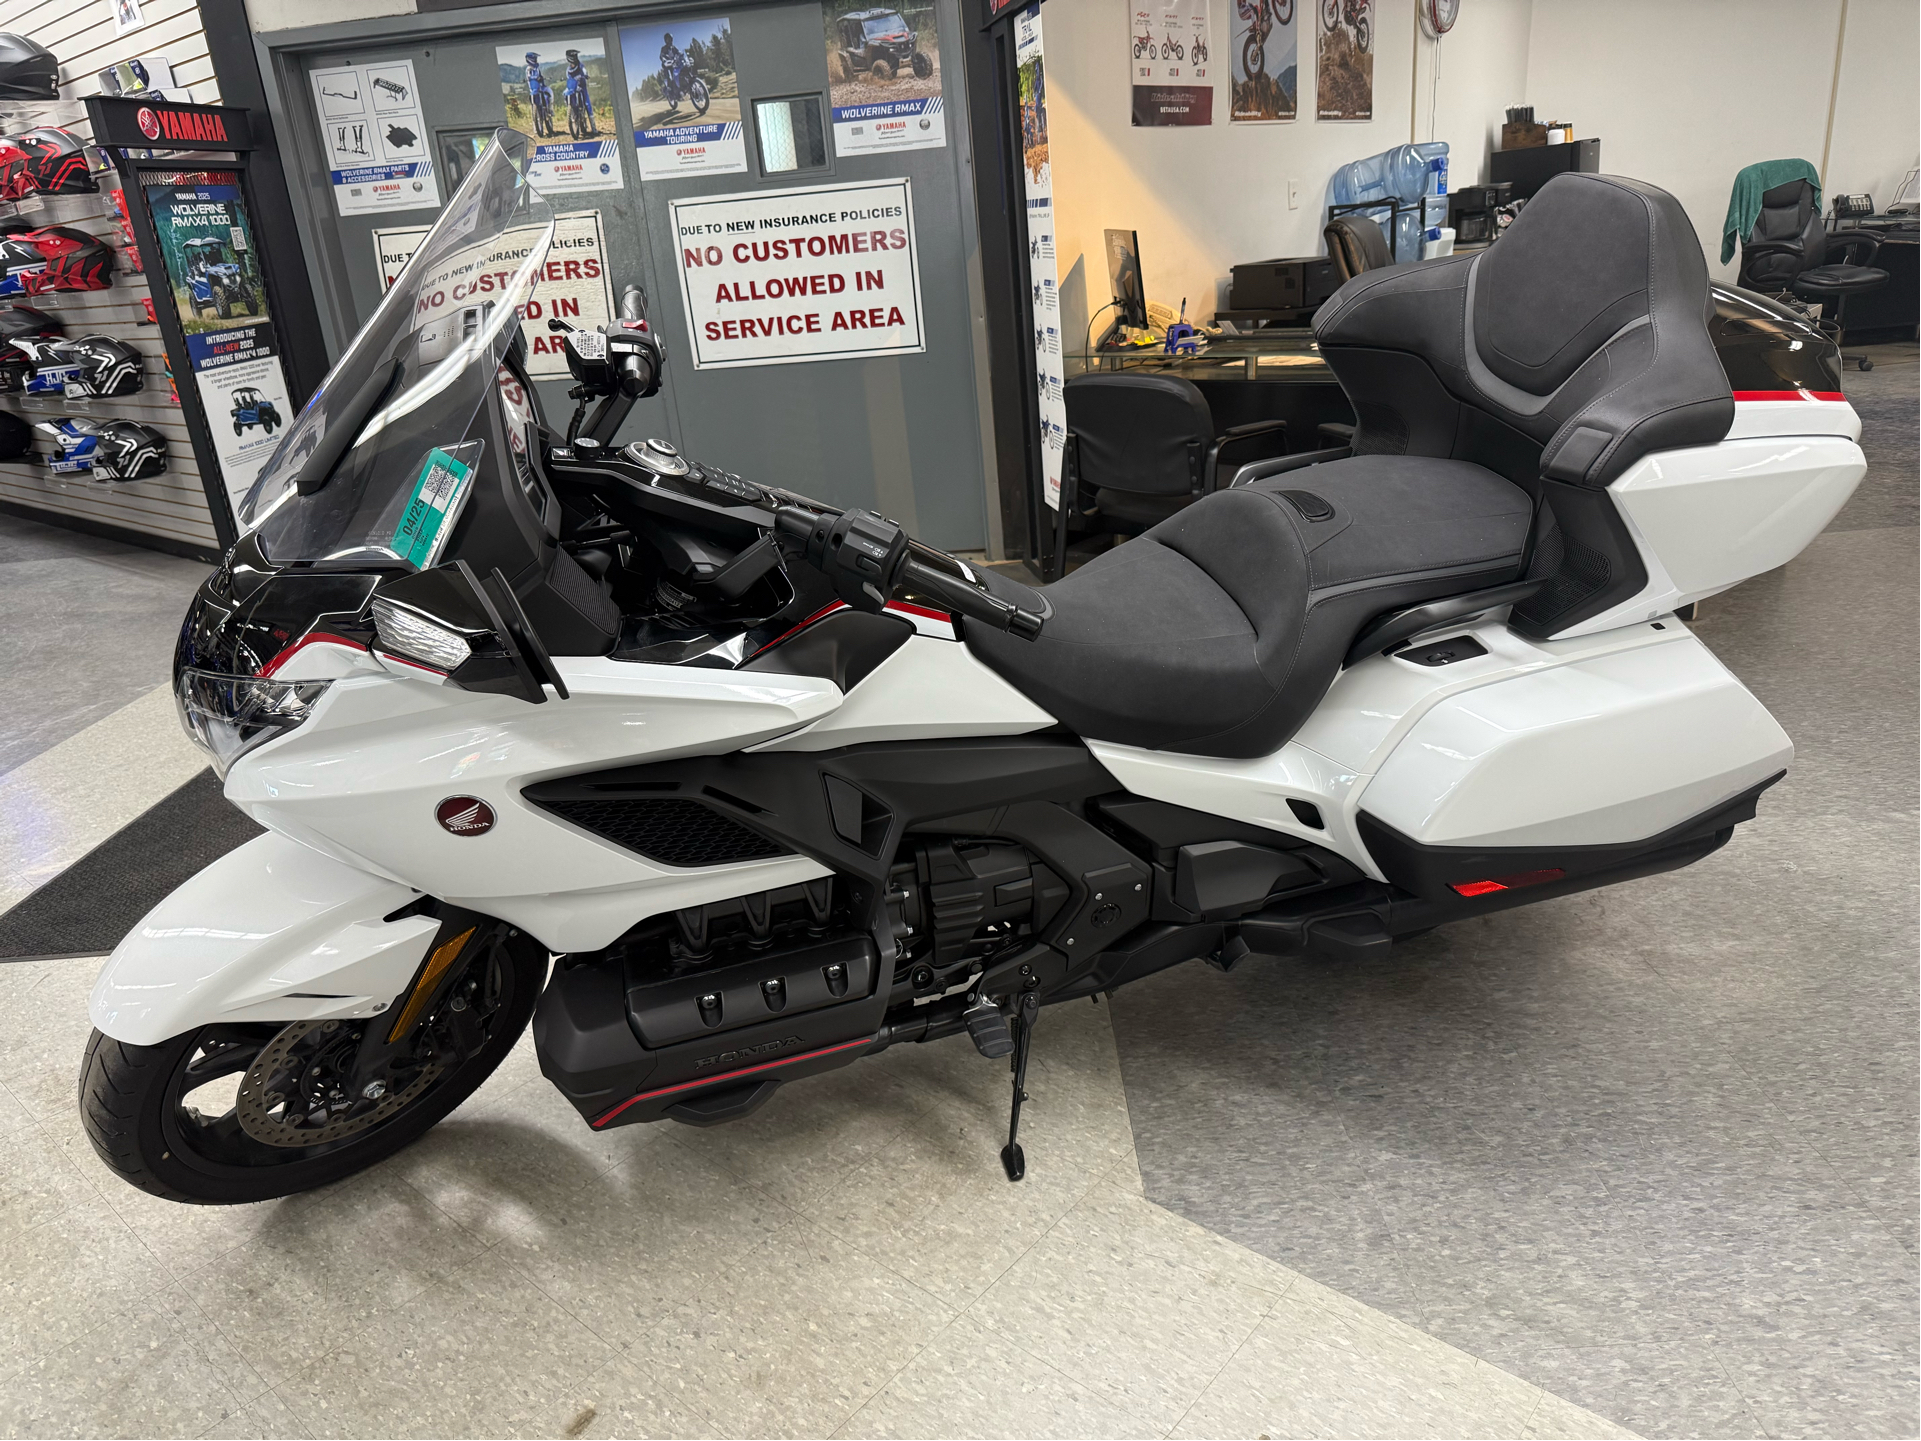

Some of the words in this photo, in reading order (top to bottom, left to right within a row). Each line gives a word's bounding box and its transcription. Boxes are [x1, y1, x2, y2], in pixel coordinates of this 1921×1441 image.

[841, 105, 893, 119] WOLVERINE
[895, 102, 922, 113] RMAX
[156, 110, 228, 142] YAMAHA
[644, 129, 674, 139] YAMAHA
[675, 125, 718, 136] ADVENTURE
[882, 121, 906, 130] YAMAHA
[666, 134, 698, 144] TOURING
[544, 144, 574, 154] YAMAHA
[683, 147, 706, 155] YAMAHA
[533, 153, 555, 162] CROSS
[556, 151, 589, 160] COUNTRY
[340, 168, 373, 178] WOLVERINE
[373, 166, 390, 174] RMAX
[391, 164, 409, 172] PARTS
[560, 164, 583, 172] YAMAHA
[347, 174, 385, 183] ACCESSORIES
[378, 183, 401, 192] YAMAHA
[197, 192, 211, 200] 2025
[170, 203, 226, 215] WOLVERINE
[209, 214, 231, 225] 1000
[681, 225, 704, 236] DUE
[705, 223, 722, 234] TO
[726, 220, 755, 233] NEW
[759, 212, 837, 230] INSURANCE
[840, 206, 903, 222] POLICIES
[683, 245, 724, 269] NO
[732, 228, 907, 264] CUSTOMERS
[383, 254, 404, 264] DUE
[421, 278, 437, 292] DUE
[438, 272, 449, 284] TO
[451, 263, 474, 278] NEW
[551, 237, 595, 249] LICIES
[715, 273, 846, 304] ALLOWED
[855, 269, 885, 292] IN
[417, 290, 445, 314] NO
[552, 297, 580, 318] IN
[704, 313, 822, 341] SERVICE
[830, 306, 906, 332] AREA
[205, 330, 245, 345] INTRODUCING
[245, 328, 256, 337] THE
[213, 342, 240, 354] ALL-NEW
[240, 339, 254, 350] 2025
[200, 354, 234, 368] WOLVERINE
[256, 346, 270, 356] 1000
[402, 497, 425, 537] 04/25
[450, 822, 490, 831] HONDA
[694, 1035, 806, 1069] HONDA
